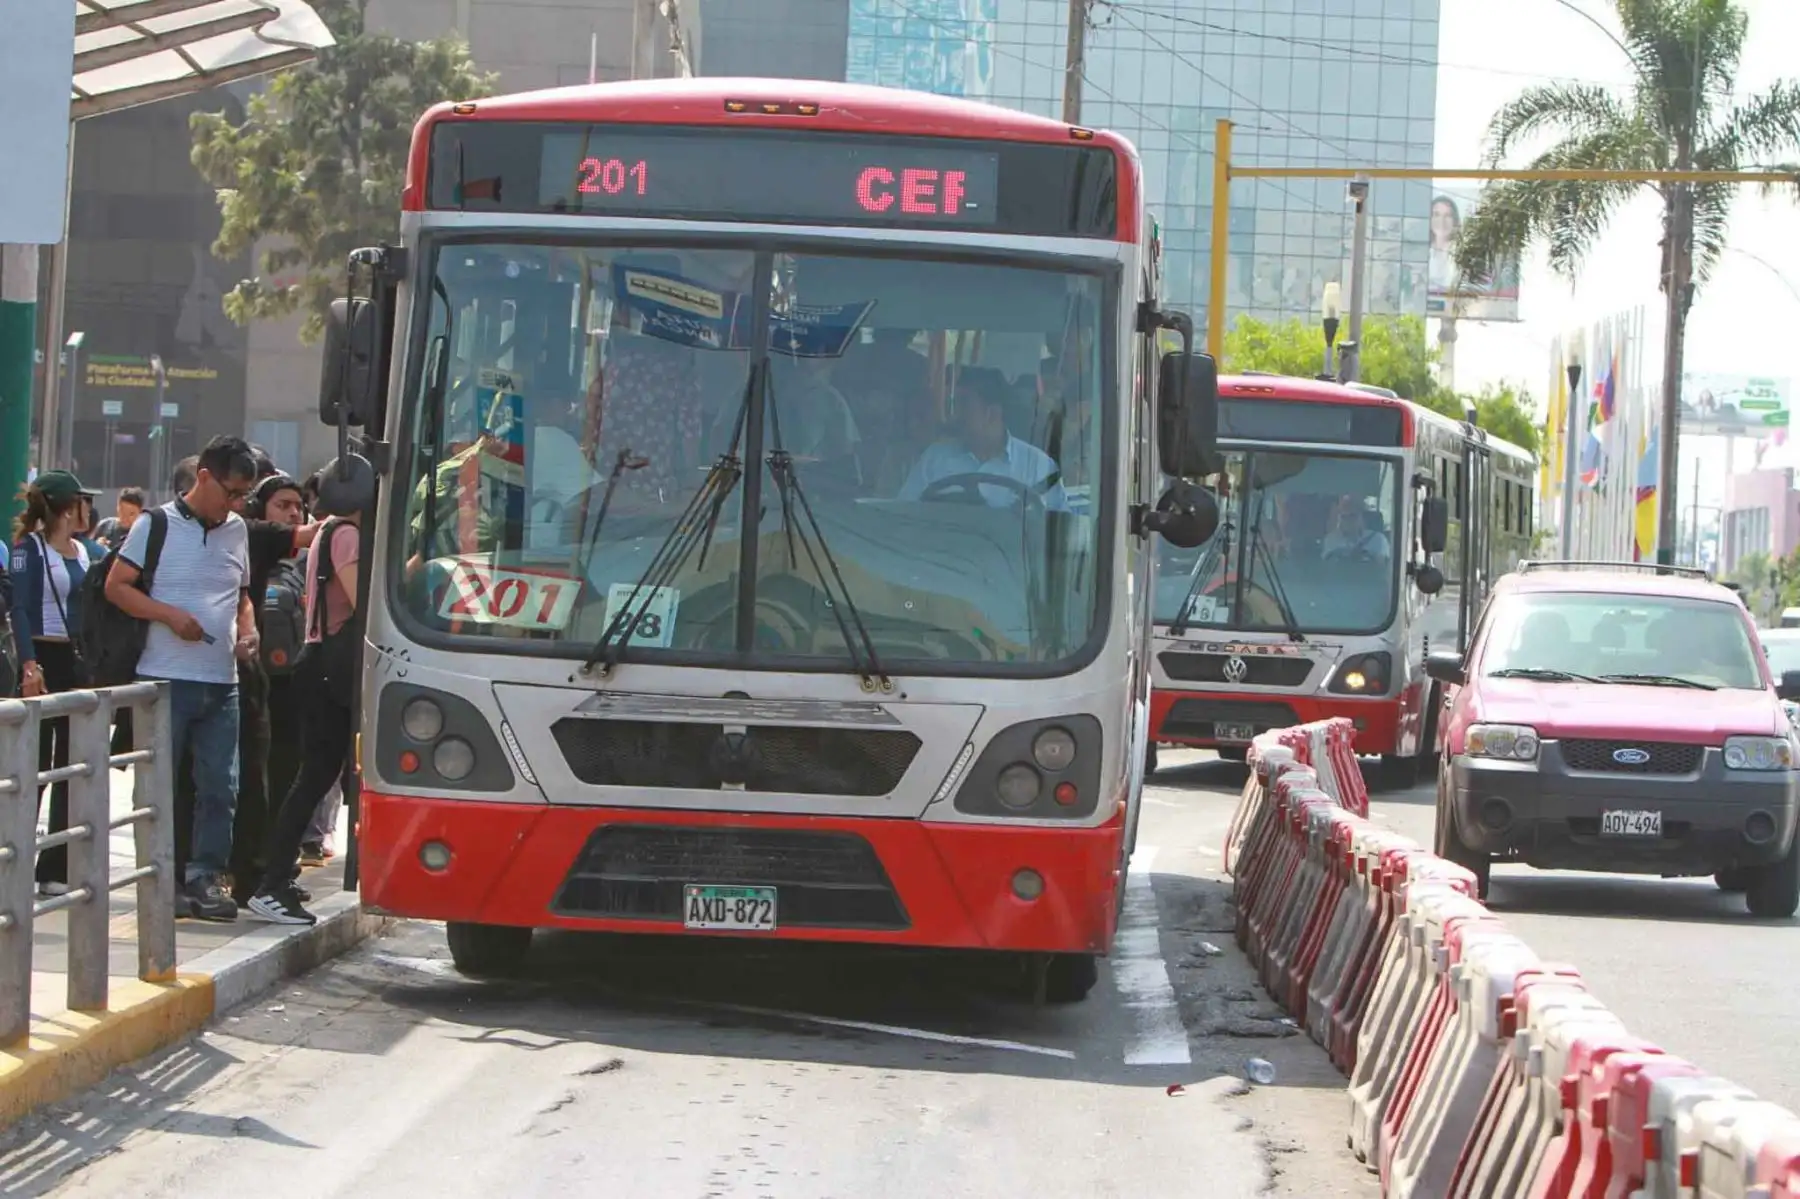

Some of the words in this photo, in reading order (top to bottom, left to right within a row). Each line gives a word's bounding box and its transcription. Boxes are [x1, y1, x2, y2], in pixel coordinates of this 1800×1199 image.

[578, 157, 647, 195] 201
[446, 573, 563, 624] 201
[689, 898, 772, 924] AXD-872
